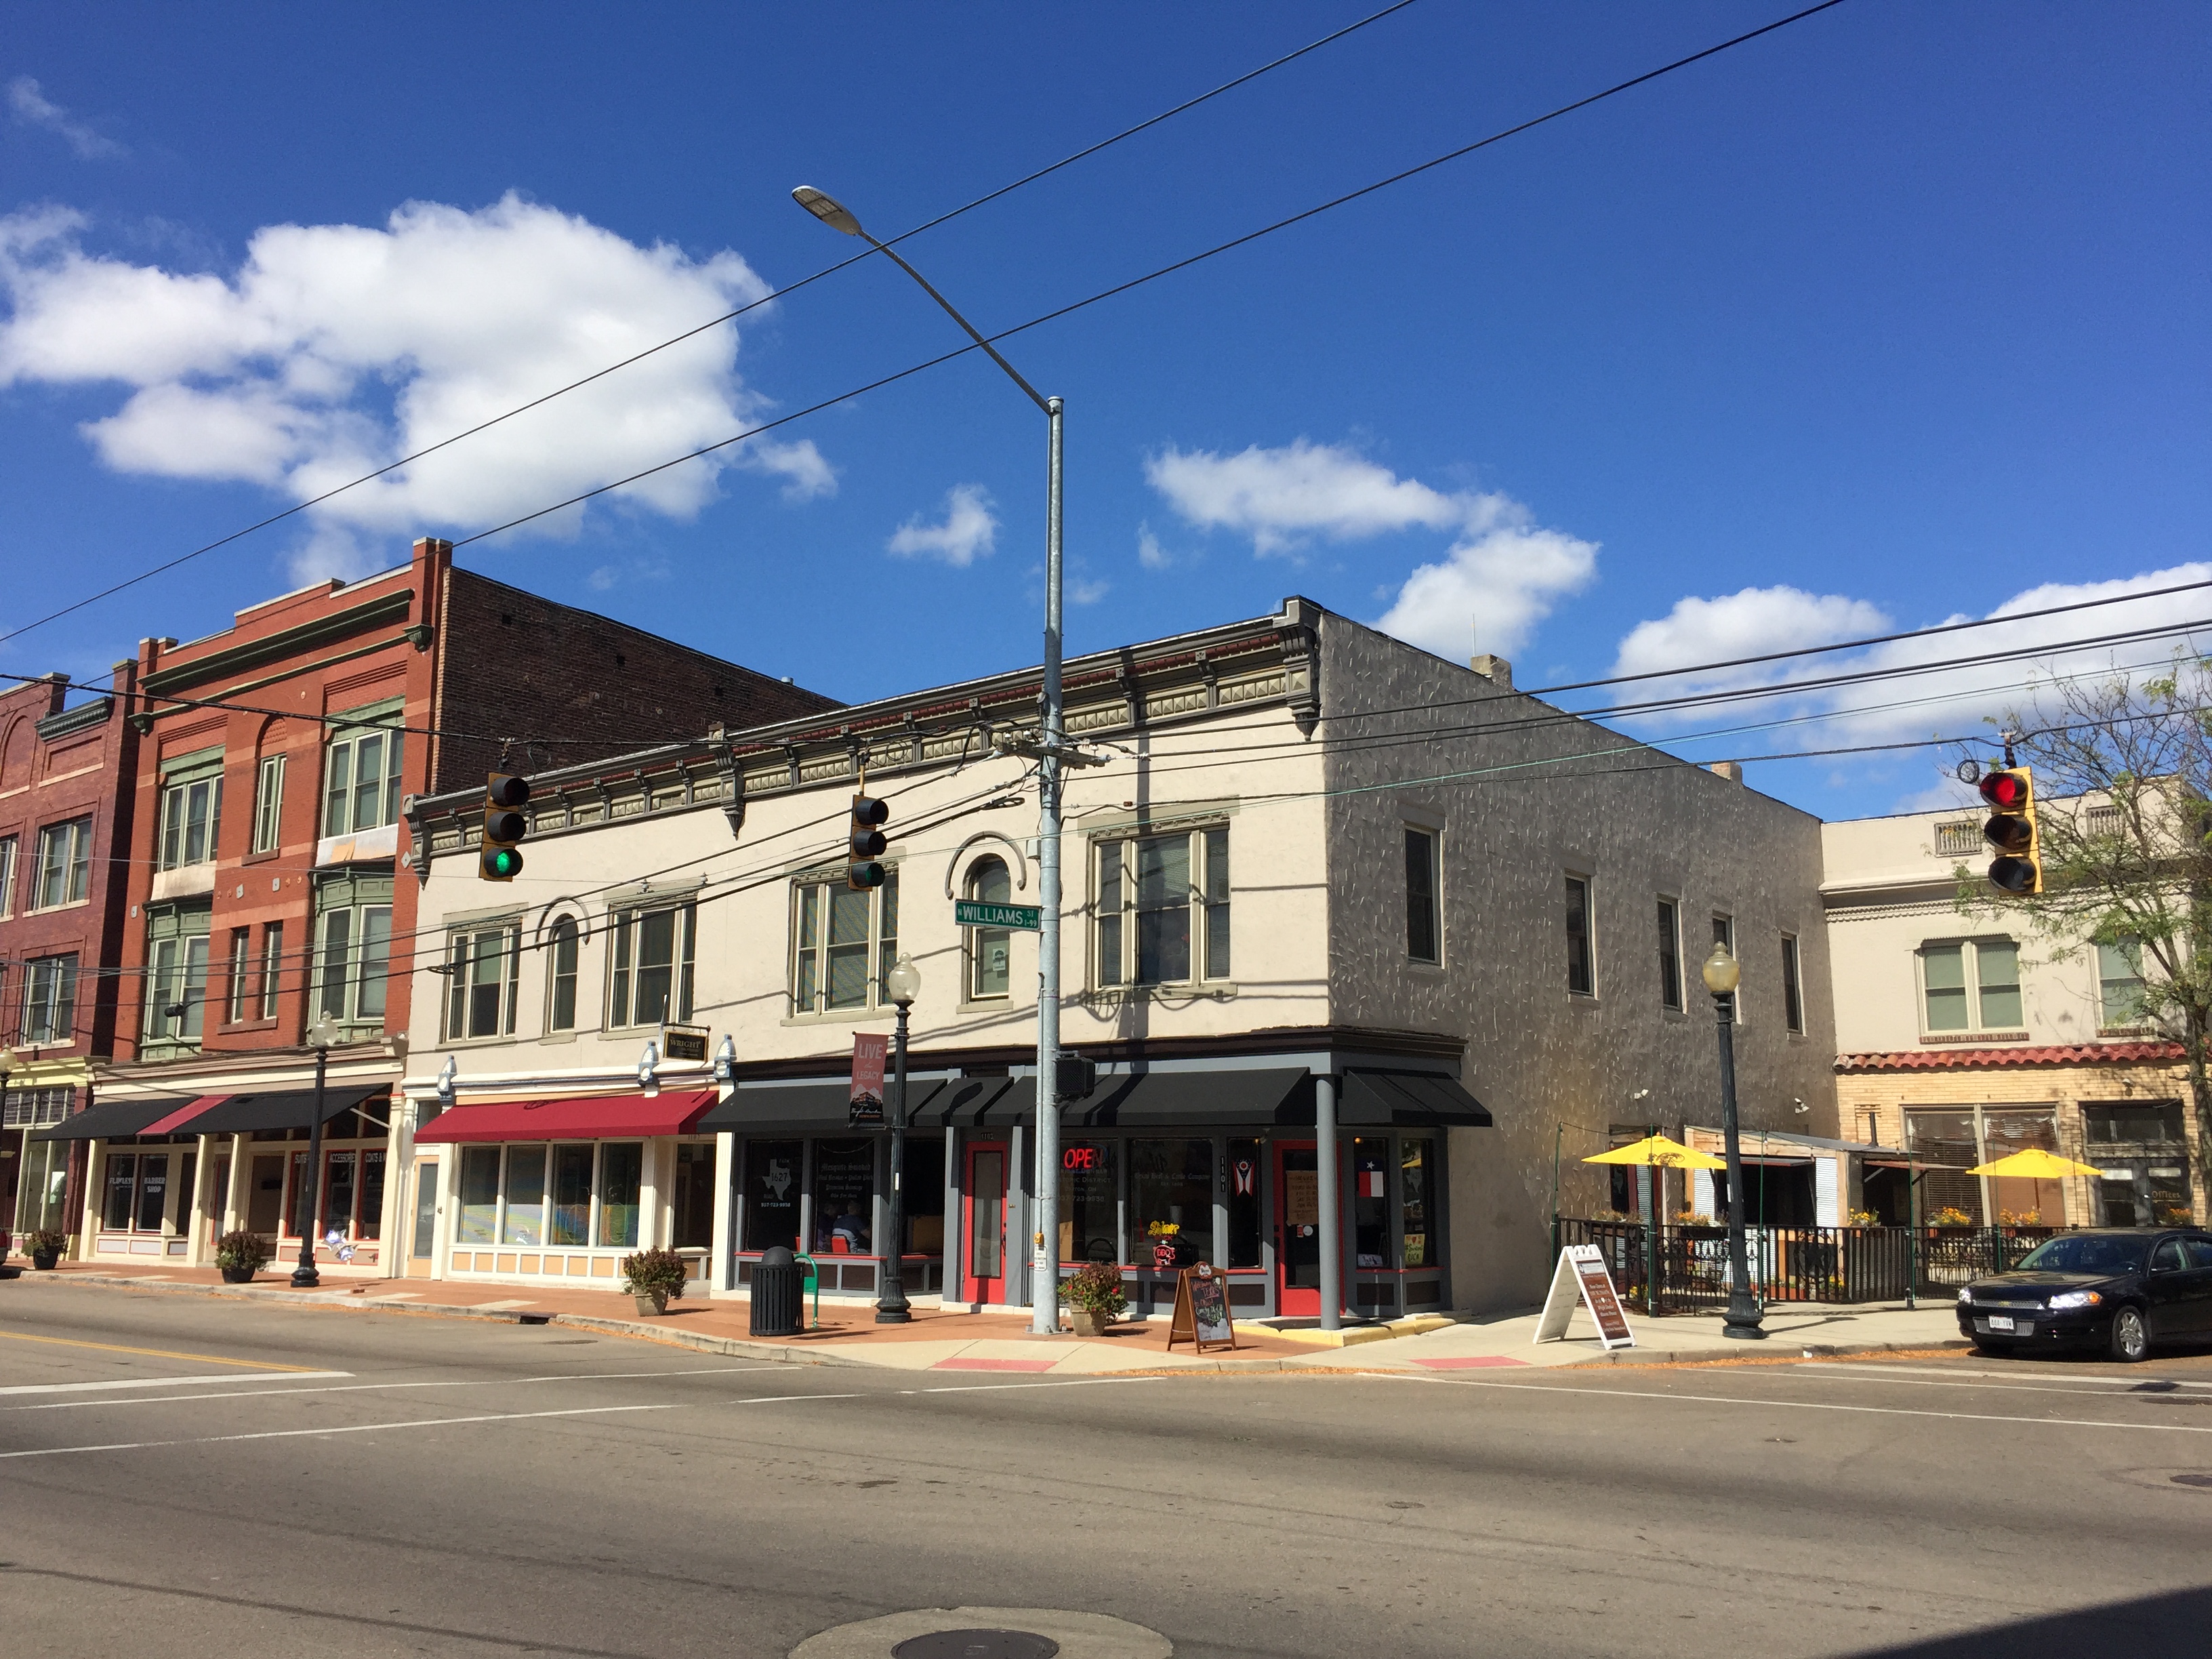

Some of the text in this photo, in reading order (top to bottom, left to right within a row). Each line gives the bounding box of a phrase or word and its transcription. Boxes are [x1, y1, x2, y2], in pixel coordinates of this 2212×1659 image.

[963, 905, 1023, 925] WILLIAMS
[670, 1039, 701, 1048] WRIGHT
[858, 1044, 883, 1059] LIVE
[857, 1071, 880, 1080] LEGACY
[329, 1153, 355, 1163] ACCESSORIE
[365, 1153, 378, 1163] COATS
[1064, 1148, 1104, 1168] OPEN
[772, 1172, 787, 1182] 1627
[2151, 1190, 2181, 1198] Offices
[1147, 1220, 1180, 1236] Shiner
[1157, 1248, 1171, 1257] BBQ
